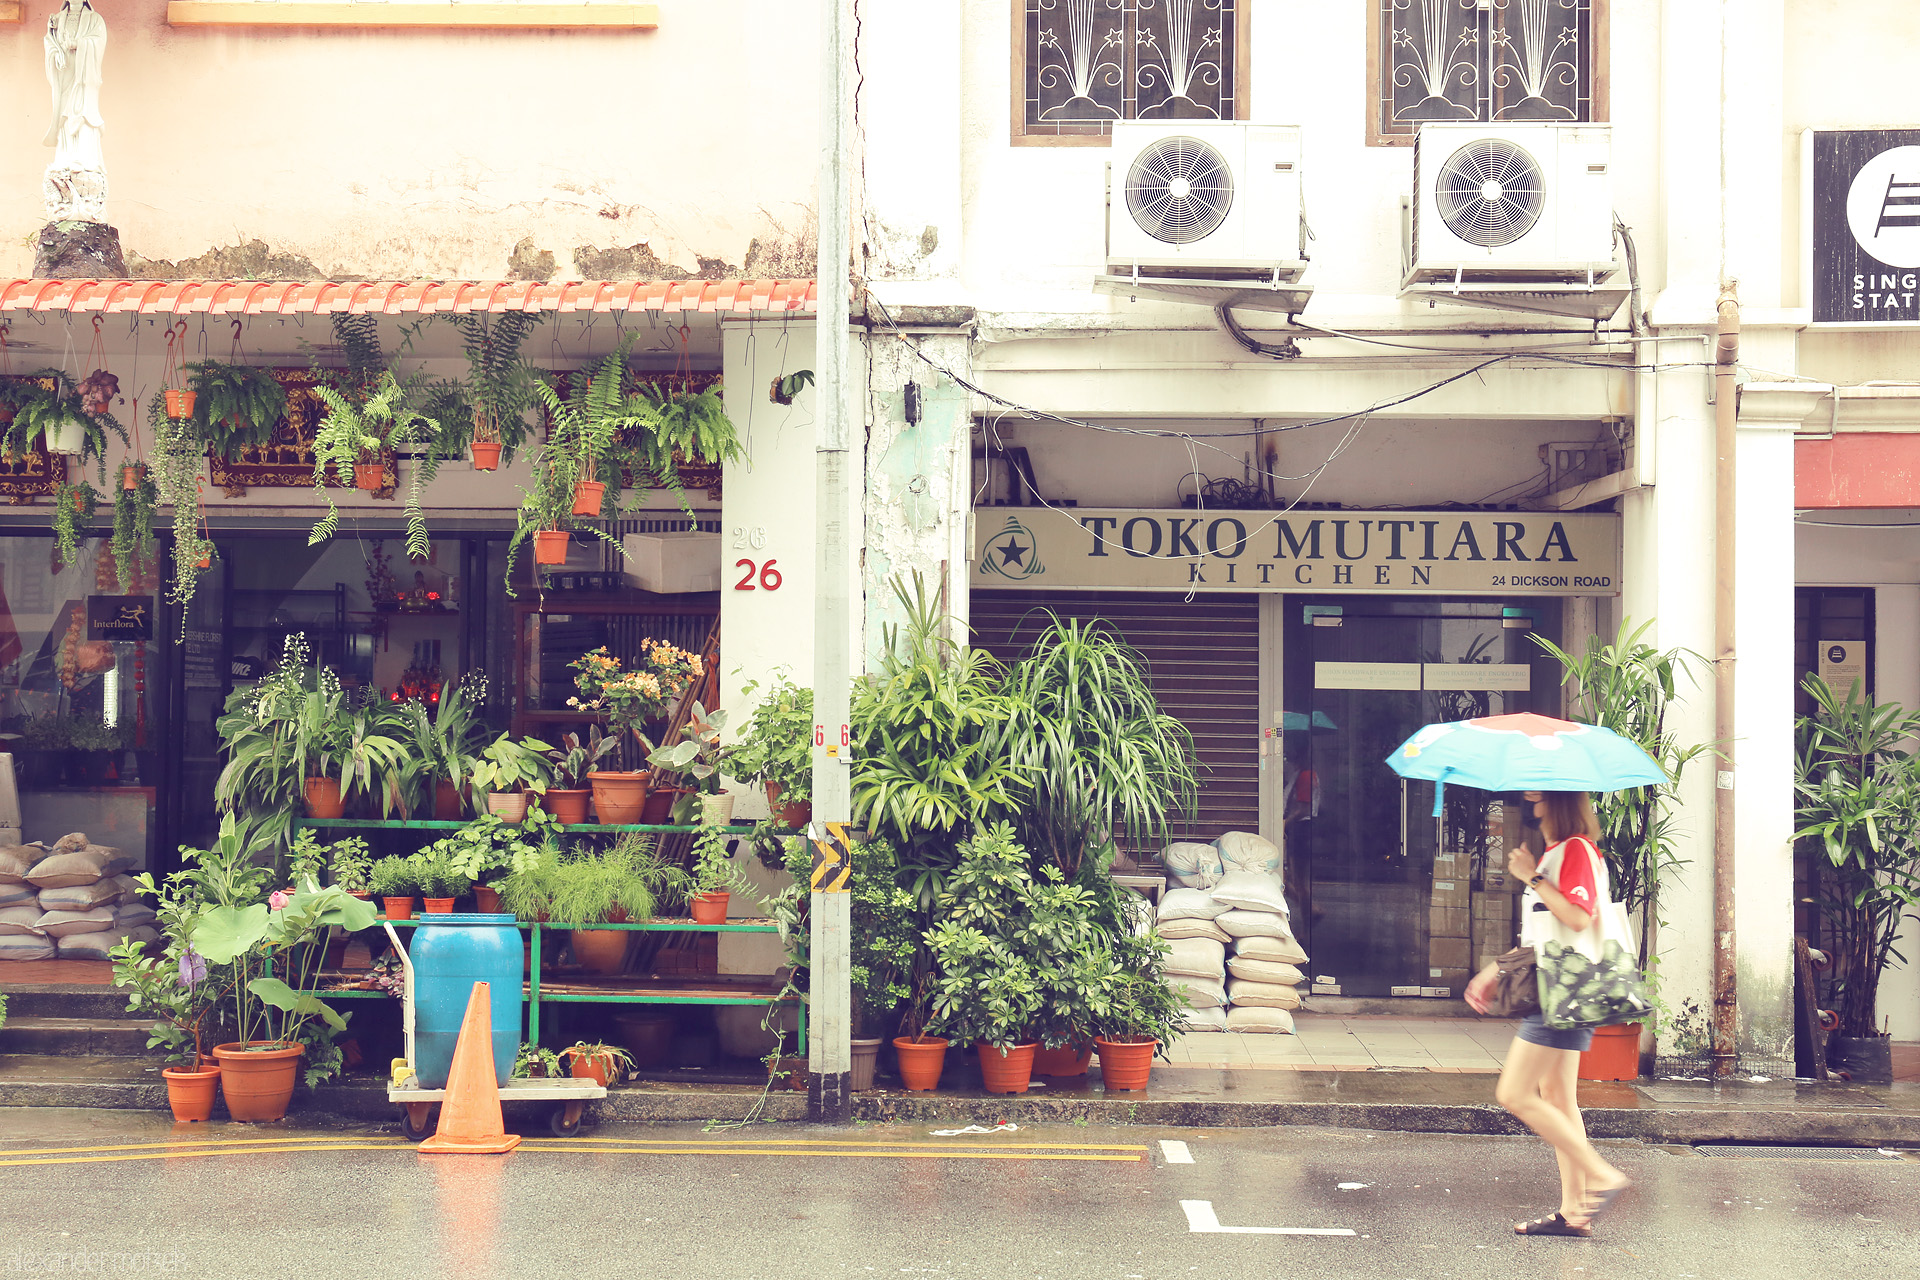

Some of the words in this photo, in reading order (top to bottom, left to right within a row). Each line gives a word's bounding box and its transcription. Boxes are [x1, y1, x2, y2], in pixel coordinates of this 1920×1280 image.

[1853, 273, 1917, 290] SING
[1852, 292, 1915, 309] STAT
[733, 527, 767, 550] 26
[1081, 517, 1247, 559] TOKO
[1273, 518, 1578, 562] MUTIARA
[735, 558, 782, 591] 26
[1188, 563, 1432, 585] KITCHEN
[1491, 576, 1506, 586] 24
[1511, 576, 1568, 587] DICKSON
[1574, 576, 1610, 587] ROAD
[94, 618, 134, 628] Interflora
[815, 724, 824, 746] 6
[841, 724, 848, 746] 6
